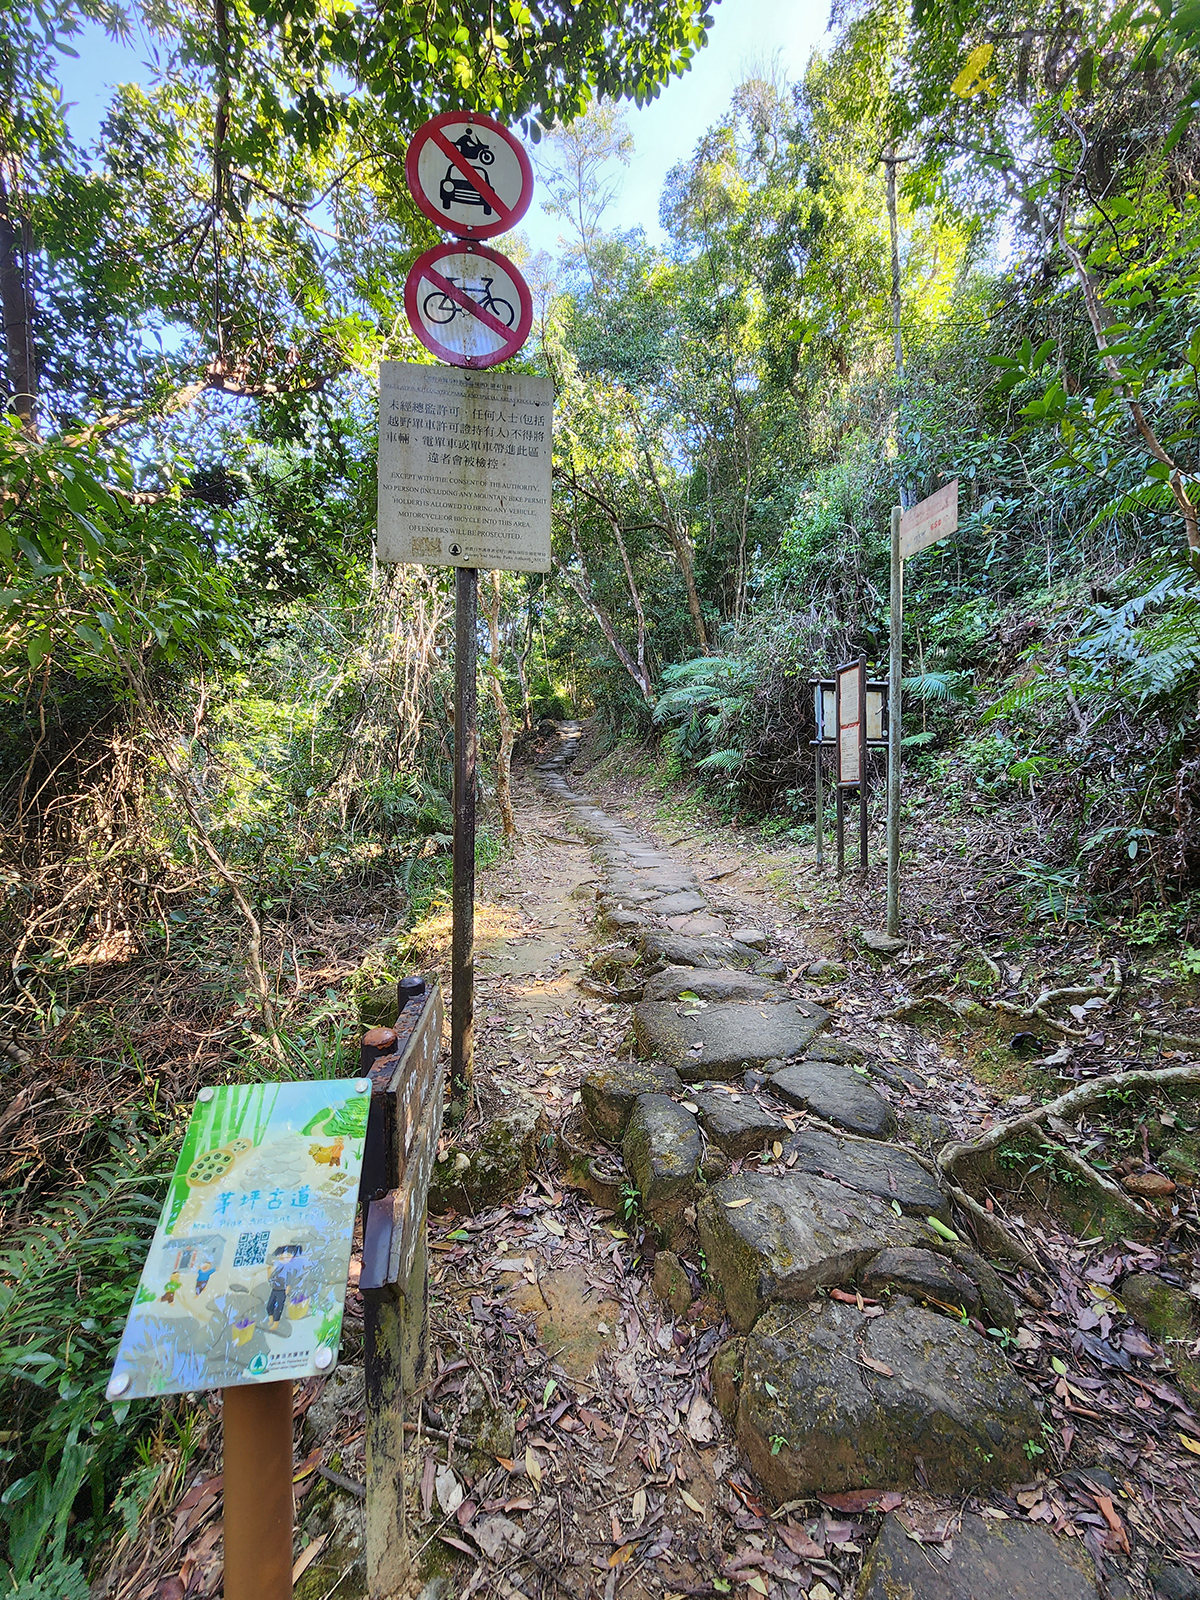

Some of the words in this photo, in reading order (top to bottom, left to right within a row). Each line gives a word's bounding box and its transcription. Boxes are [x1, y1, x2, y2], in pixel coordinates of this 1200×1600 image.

[391, 472, 415, 480] EXCEPT
[449, 477, 479, 485] CONSENT
[394, 485, 419, 493] PERSON
[420, 487, 458, 496] (INCLUDING
[474, 493, 508, 501] MOUNTAIN
[393, 498, 423, 506] HOLDER)
[430, 501, 462, 509] ALLOWED
[398, 511, 443, 520] MOTORCYCLE
[409, 525, 449, 533] OFFENDERS
[213, 1185, 310, 1214] 茅坪古道
